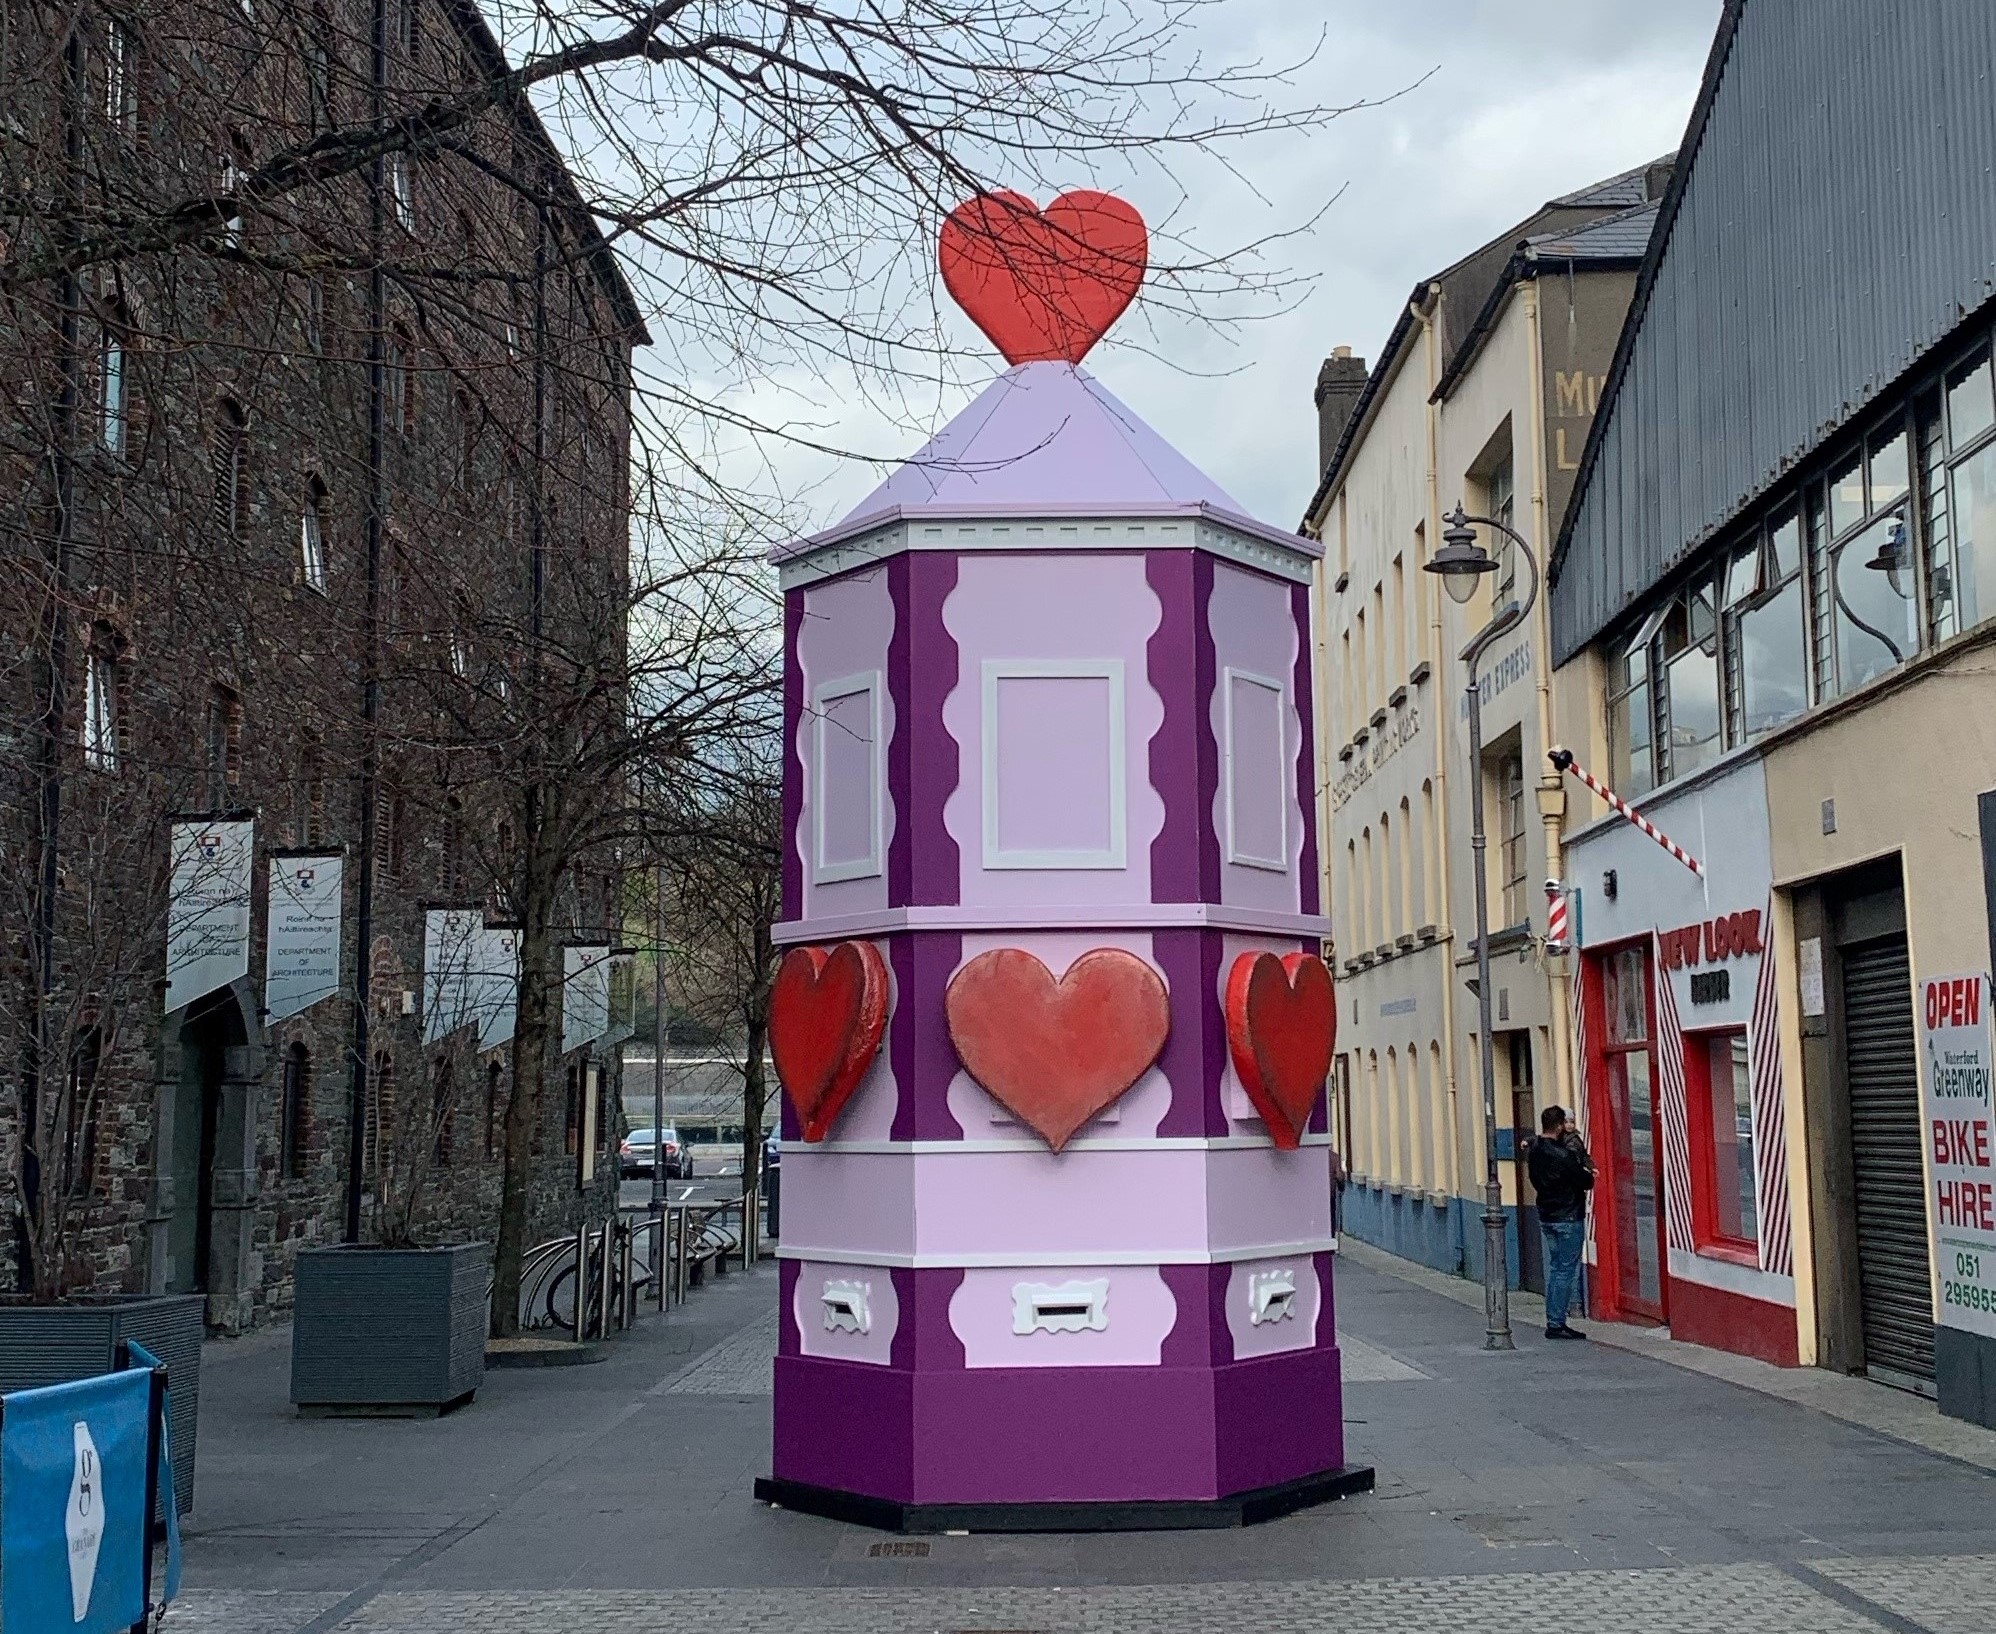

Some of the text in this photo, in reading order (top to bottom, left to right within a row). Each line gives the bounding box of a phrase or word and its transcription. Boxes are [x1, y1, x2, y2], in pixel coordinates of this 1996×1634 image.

[1495, 640, 1531, 695] EXPRESS
[277, 947, 331, 956] DEPARTMENT
[1659, 908, 1764, 970] NEW LOOK
[272, 968, 333, 977] ARCHITECTURE
[298, 958, 309, 966] OF
[1926, 978, 1980, 1031] OPEN
[1944, 1049, 1979, 1065] Waterford
[1933, 1059, 1989, 1107] Greenway
[1932, 1119, 1990, 1167] BIKE
[1937, 1180, 1994, 1231] HIRE
[1956, 1252, 1980, 1279] 051
[1944, 1280, 1996, 1314] 295955
